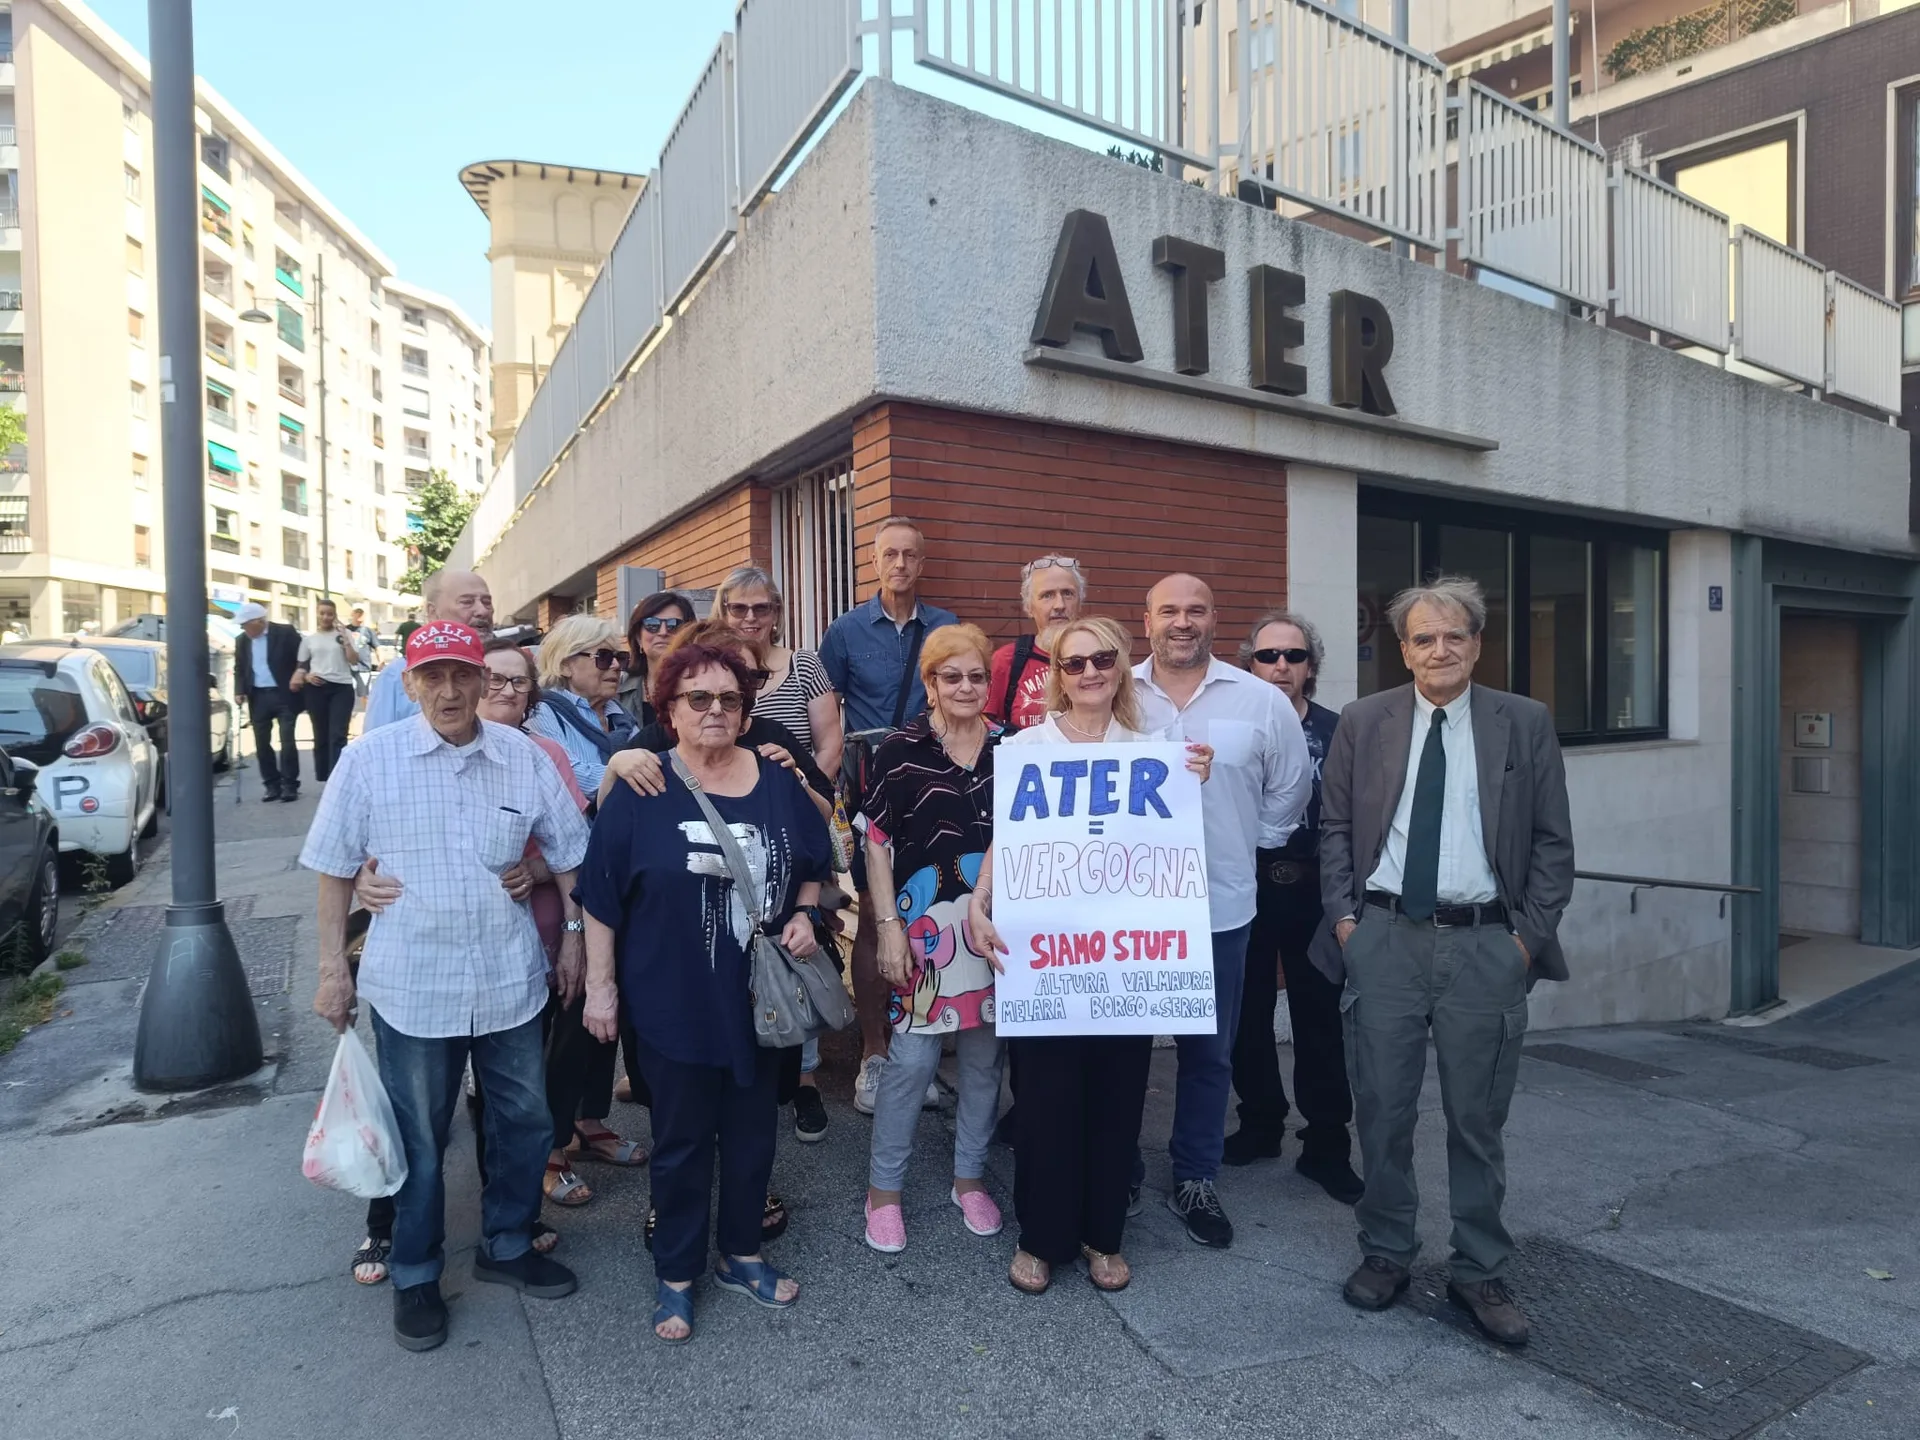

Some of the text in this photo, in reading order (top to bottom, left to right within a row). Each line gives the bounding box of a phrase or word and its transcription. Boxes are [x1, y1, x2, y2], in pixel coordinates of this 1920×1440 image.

[1030, 208, 1398, 416] ATER
[410, 623, 473, 648] ITALIA
[52, 775, 90, 811] P
[1009, 757, 1173, 822] ATER
[1001, 840, 1208, 901] VERGOGNA
[1029, 930, 1187, 970] SIAMO STUFI
[1035, 970, 1213, 996] ALTURA VALMAURA
[1001, 997, 1066, 1023] MELARA
[1090, 995, 1148, 1019] BORGO
